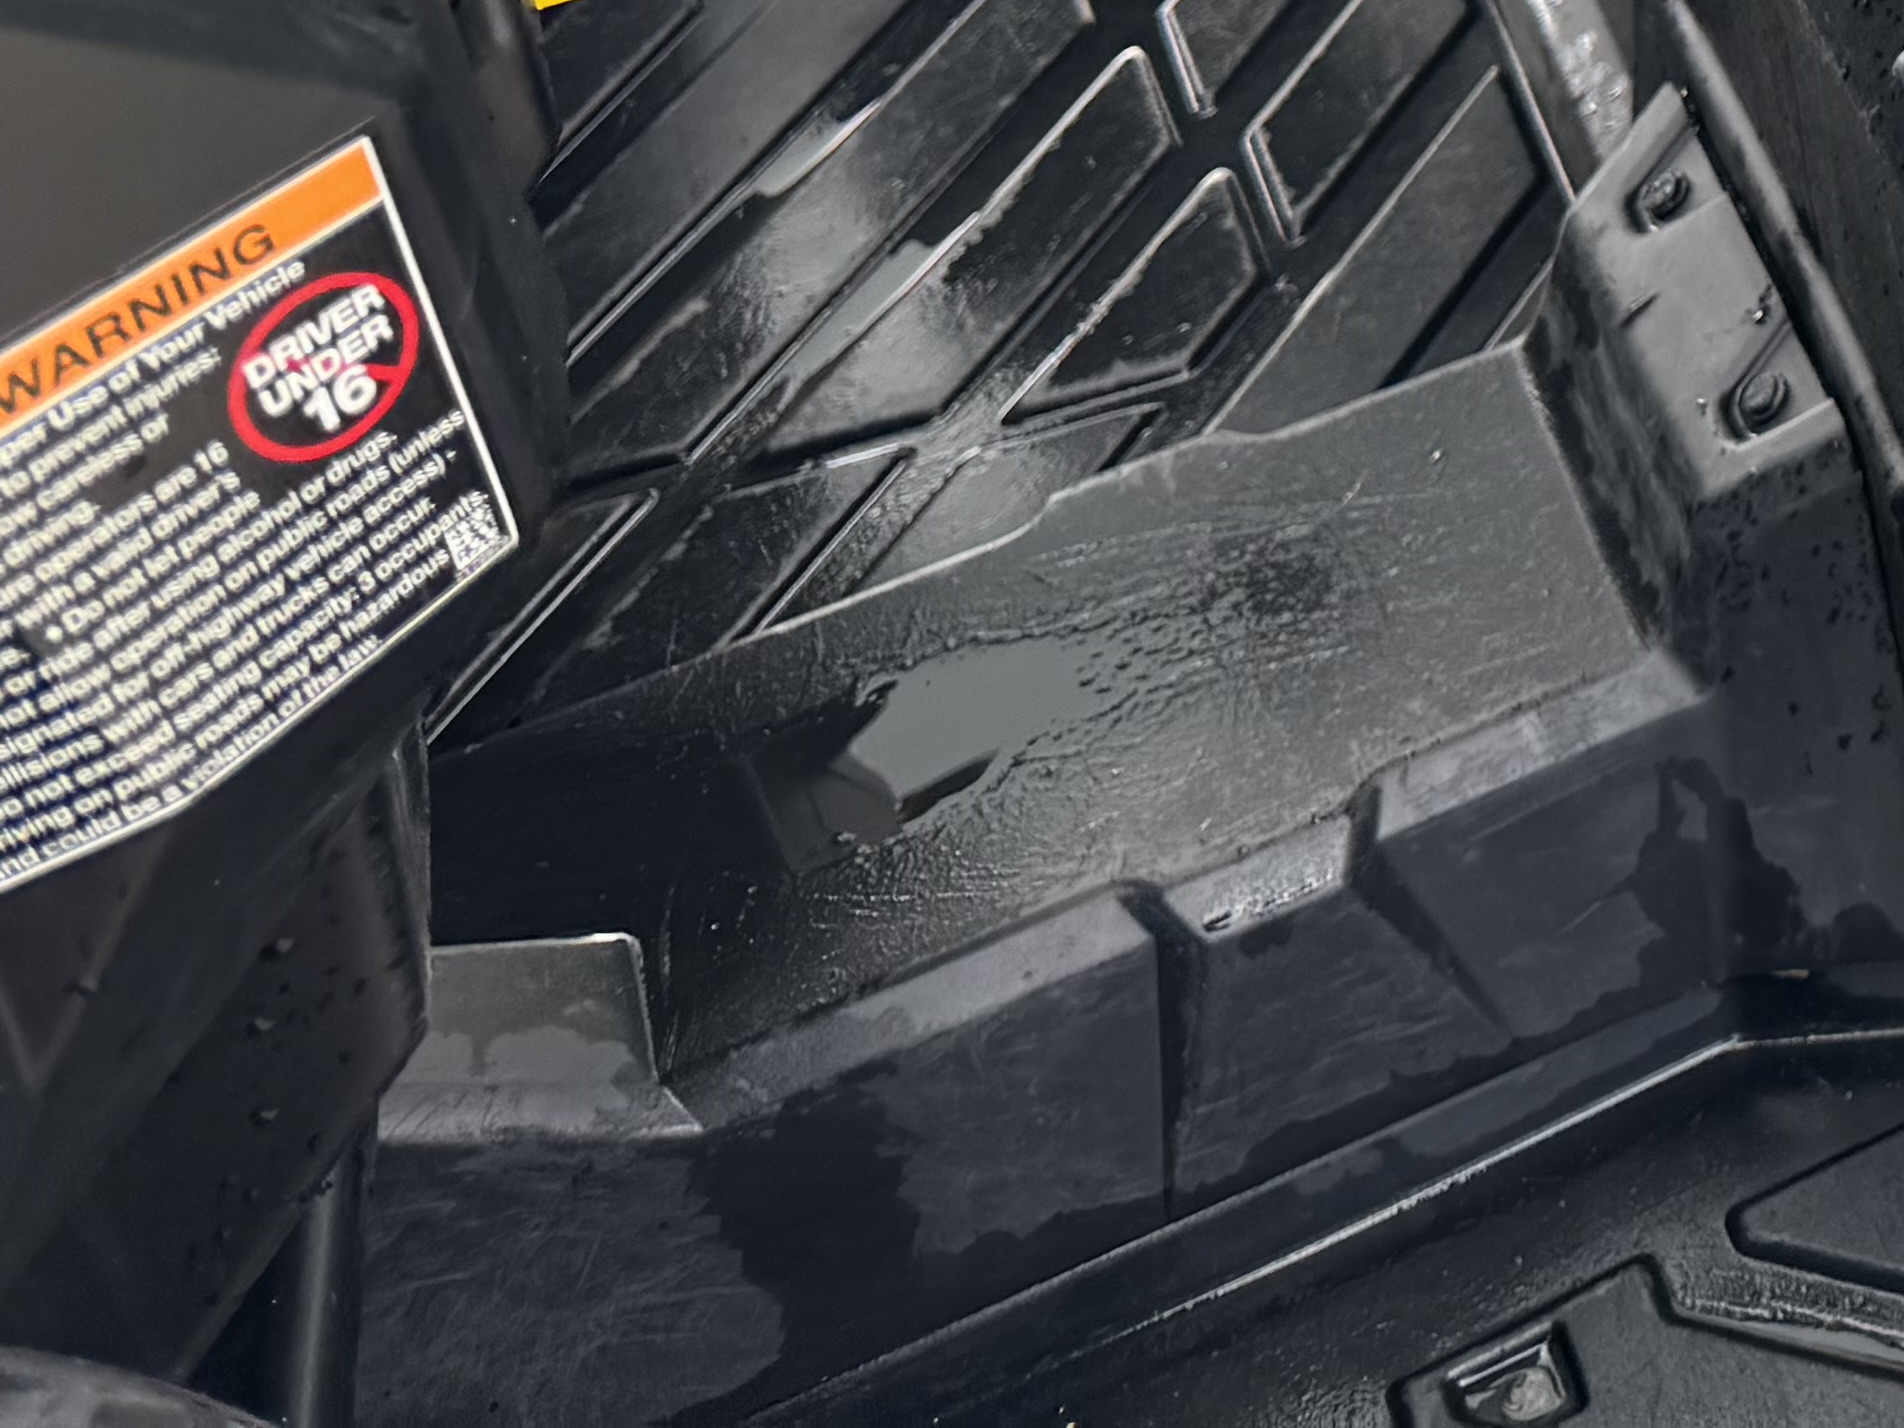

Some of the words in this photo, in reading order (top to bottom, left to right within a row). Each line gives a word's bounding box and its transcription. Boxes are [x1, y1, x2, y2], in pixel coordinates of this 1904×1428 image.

[0, 224, 275, 413] WARNING
[47, 385, 109, 432] Use
[108, 358, 141, 394] of
[137, 322, 205, 371] Your
[203, 260, 305, 331] Vehicle
[241, 284, 386, 390] DRIVER
[257, 314, 394, 418] UNDER
[303, 363, 377, 432] 16
[28, 404, 128, 484] prevent
[35, 493, 157, 583] operators
[154, 466, 197, 504] are
[193, 440, 229, 475] 16
[36, 432, 144, 510] careless
[140, 411, 169, 443] or
[3, 499, 101, 568] driving.
[15, 584, 76, 628] with
[73, 572, 95, 593] a
[91, 527, 154, 580] valid
[151, 471, 241, 539] driver's
[37, 663, 111, 712] allow
[110, 584, 227, 672] operation
[224, 560, 259, 592] on
[255, 510, 328, 573] public
[325, 464, 391, 519] roads
[388, 409, 465, 475] (unless
[38, 643, 95, 681] ride
[93, 601, 151, 649] after
[150, 554, 220, 609] using
[217, 490, 302, 564] alcohol
[300, 476, 326, 504] or
[325, 431, 398, 486] drugs.
[61, 600, 105, 634] Do
[103, 567, 148, 608] not
[142, 545, 180, 580] let
[177, 491, 261, 561] people
[111, 670, 150, 704] for
[282, 516, 364, 581] vehicle
[362, 452, 446, 526] access)
[24, 773, 75, 809] not
[74, 720, 175, 786] exceed
[173, 660, 262, 731] seating
[258, 586, 360, 669] capacity:
[357, 570, 376, 593] 3
[374, 491, 489, 581] occupants.
[73, 789, 114, 816] on
[113, 742, 197, 801] public
[194, 693, 265, 750] roads
[261, 655, 311, 702] may
[307, 632, 342, 664] be
[338, 548, 450, 641] hazardous
[102, 699, 162, 743] with
[158, 662, 215, 709] cars
[212, 623, 260, 671] and
[255, 576, 330, 637] trucks
[327, 545, 372, 583] can
[368, 496, 437, 553] occur.
[42, 808, 122, 856] could
[121, 795, 161, 822] be
[181, 712, 280, 790] violation
[278, 689, 303, 718] of
[301, 665, 340, 698] the
